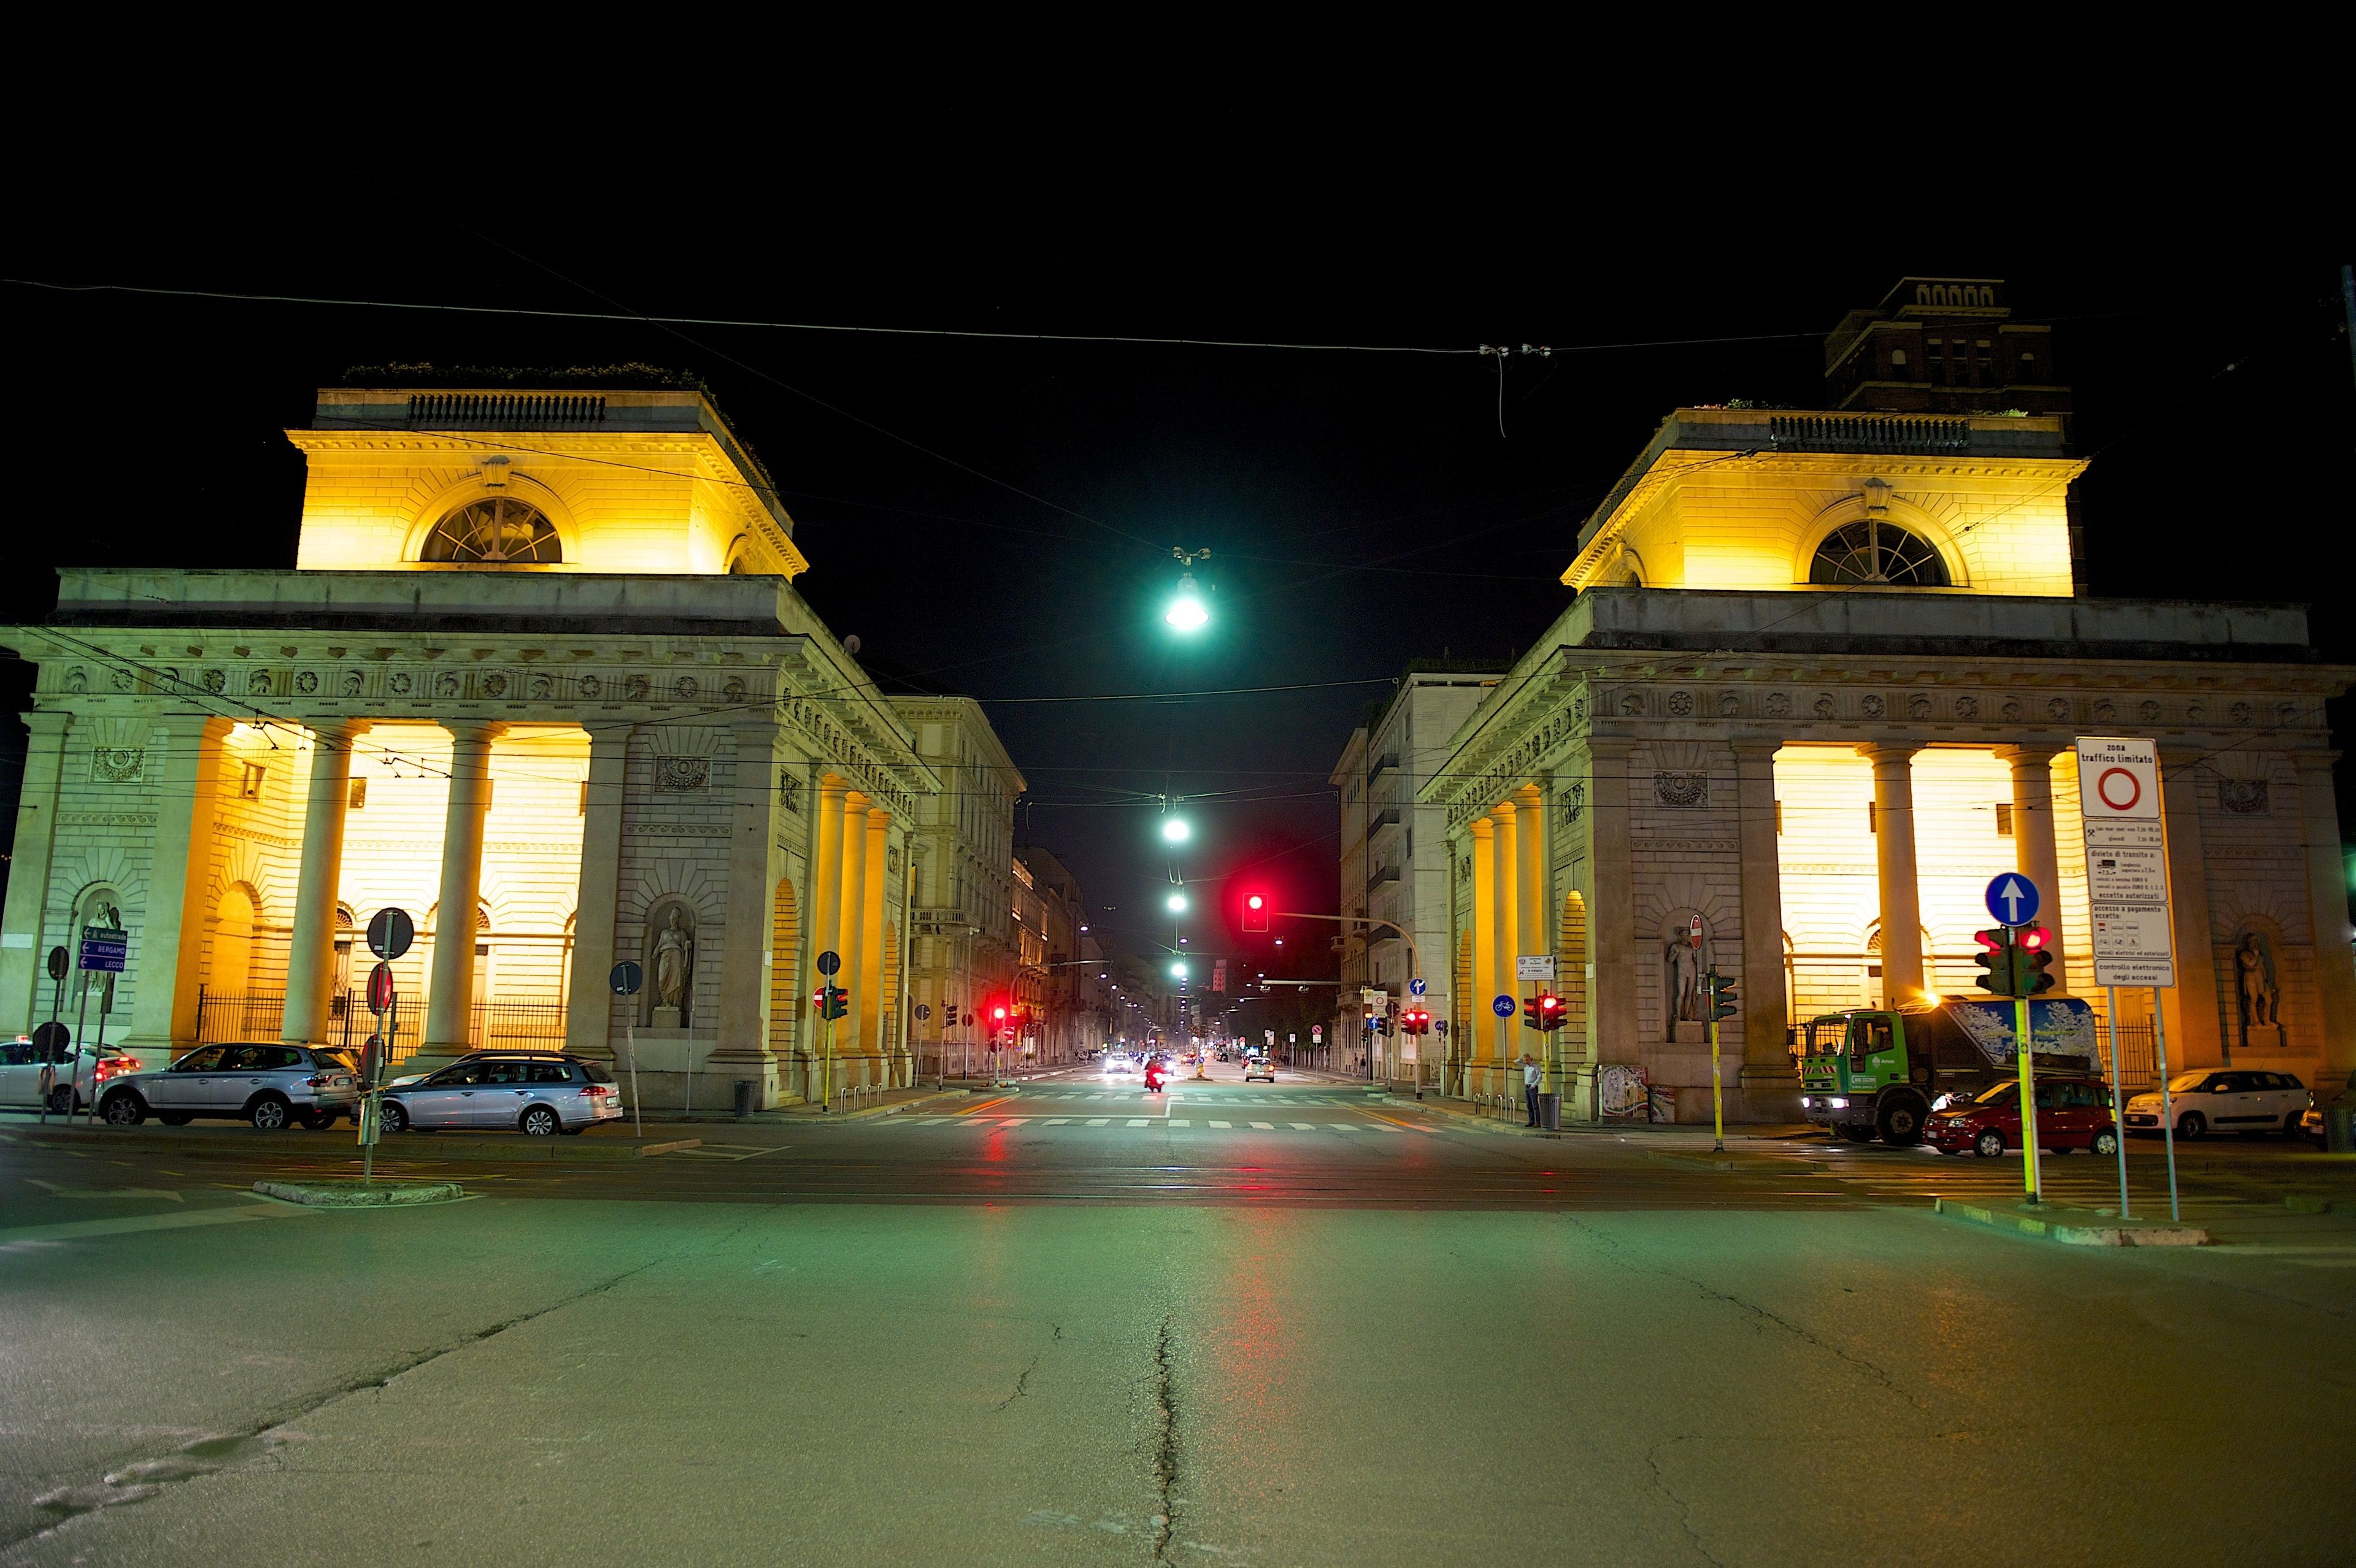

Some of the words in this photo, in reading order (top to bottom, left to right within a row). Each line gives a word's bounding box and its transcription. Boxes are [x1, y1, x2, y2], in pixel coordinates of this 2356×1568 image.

[2082, 753, 2115, 763] traffico
[2118, 754, 2153, 764] limitato
[98, 945, 125, 955] BERGAMO
